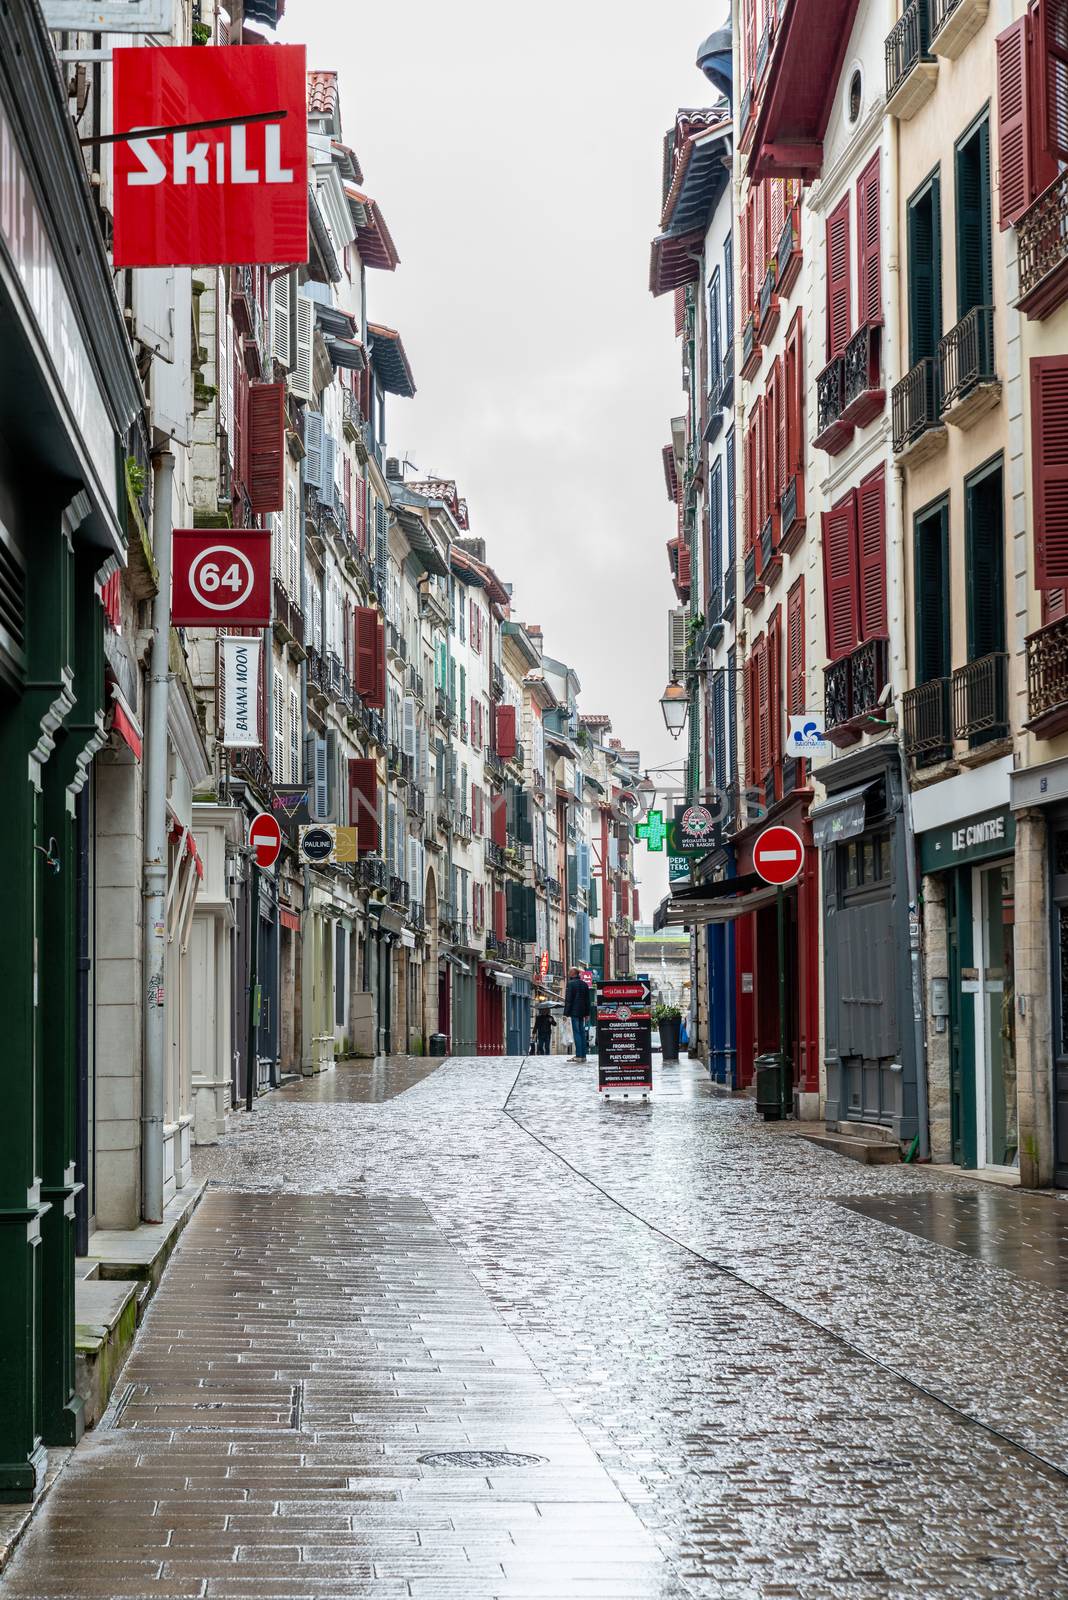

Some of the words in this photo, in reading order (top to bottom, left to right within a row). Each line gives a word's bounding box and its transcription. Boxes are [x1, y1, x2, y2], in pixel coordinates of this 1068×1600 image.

[199, 563, 242, 592] 64
[235, 645, 248, 684] MOON
[235, 686, 248, 732] BANANA
[952, 828, 966, 851] LE
[966, 816, 1004, 846] CINTRE
